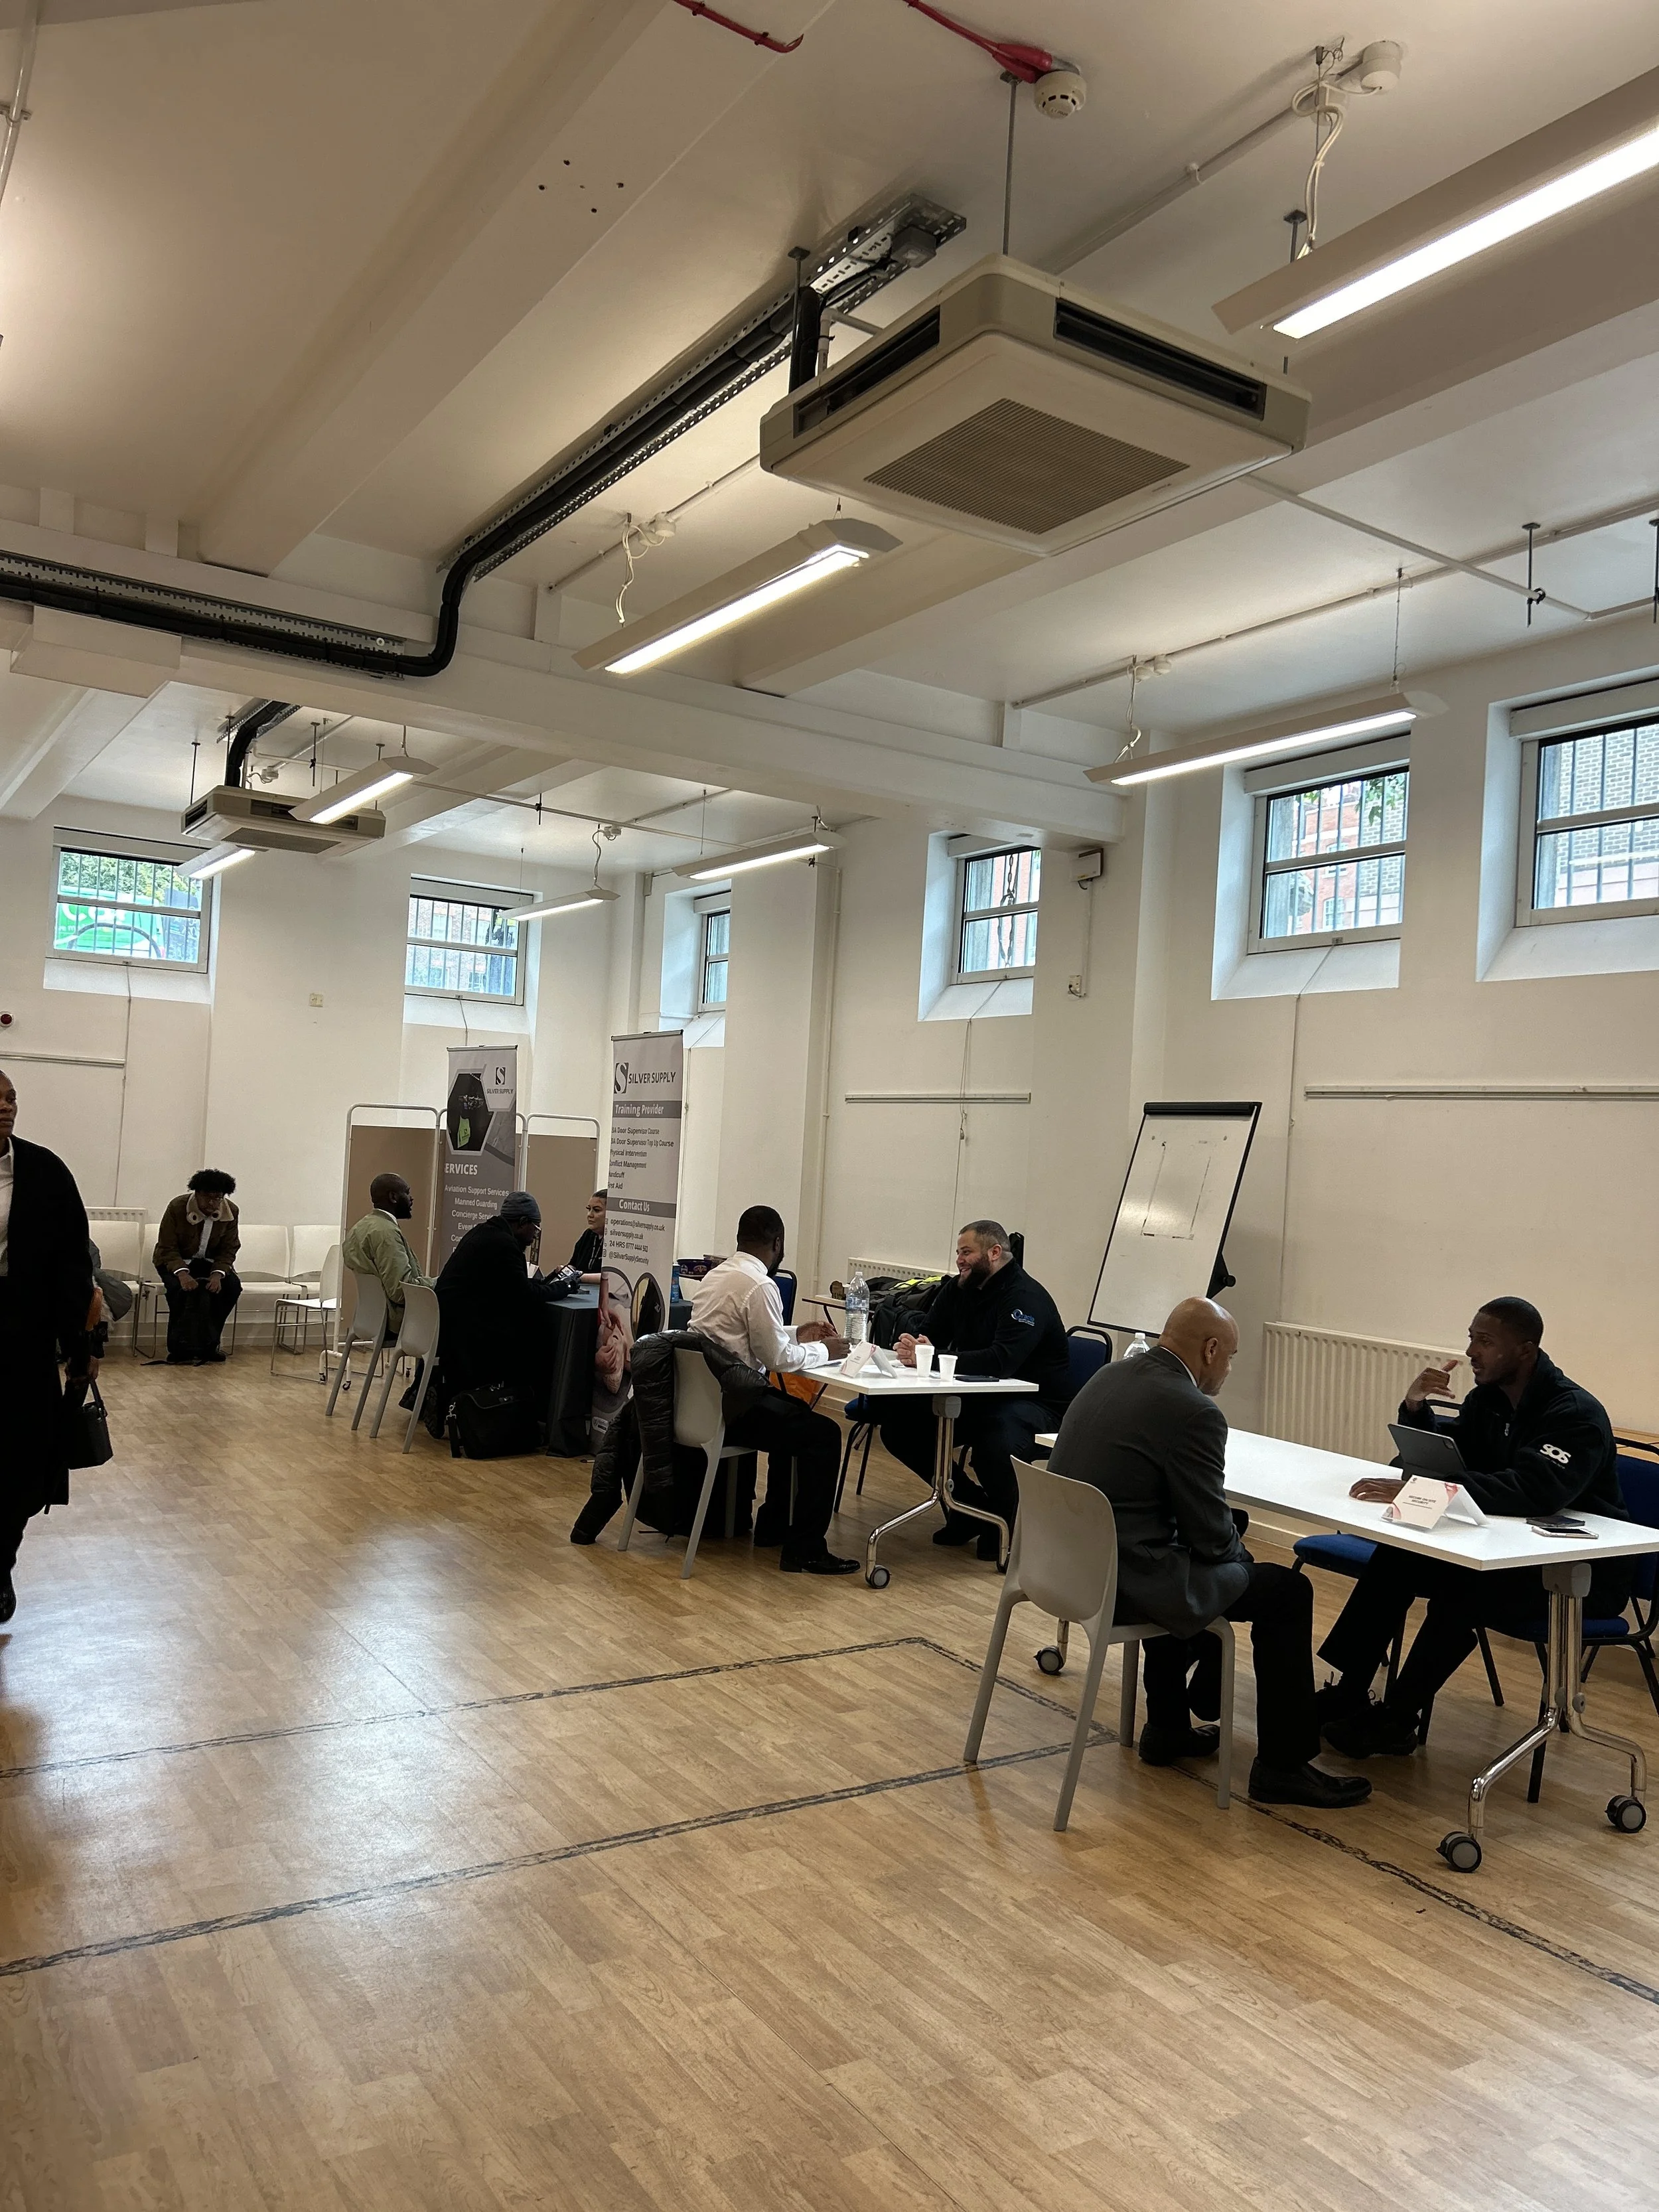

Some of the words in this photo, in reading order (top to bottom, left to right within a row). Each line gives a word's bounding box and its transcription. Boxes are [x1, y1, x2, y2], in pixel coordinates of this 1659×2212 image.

[628, 1072, 650, 1084] SILVER
[651, 1071, 676, 1084] SUPPLY
[615, 1104, 640, 1117] Training
[641, 1103, 664, 1115] Provider
[627, 1127, 648, 1136] Supervisor
[626, 1138, 647, 1147] Supervisor
[445, 1163, 478, 1175] ERVICES
[445, 1185, 467, 1193] Aviation
[467, 1186, 487, 1195] Support
[487, 1188, 510, 1197] Services
[455, 1197, 475, 1207] Manned
[476, 1199, 498, 1210] Guarding
[619, 1199, 642, 1211] Contact
[643, 1201, 650, 1212] Us
[452, 1209, 478, 1220] Concierge
[1540, 1443, 1571, 1464] SOS
